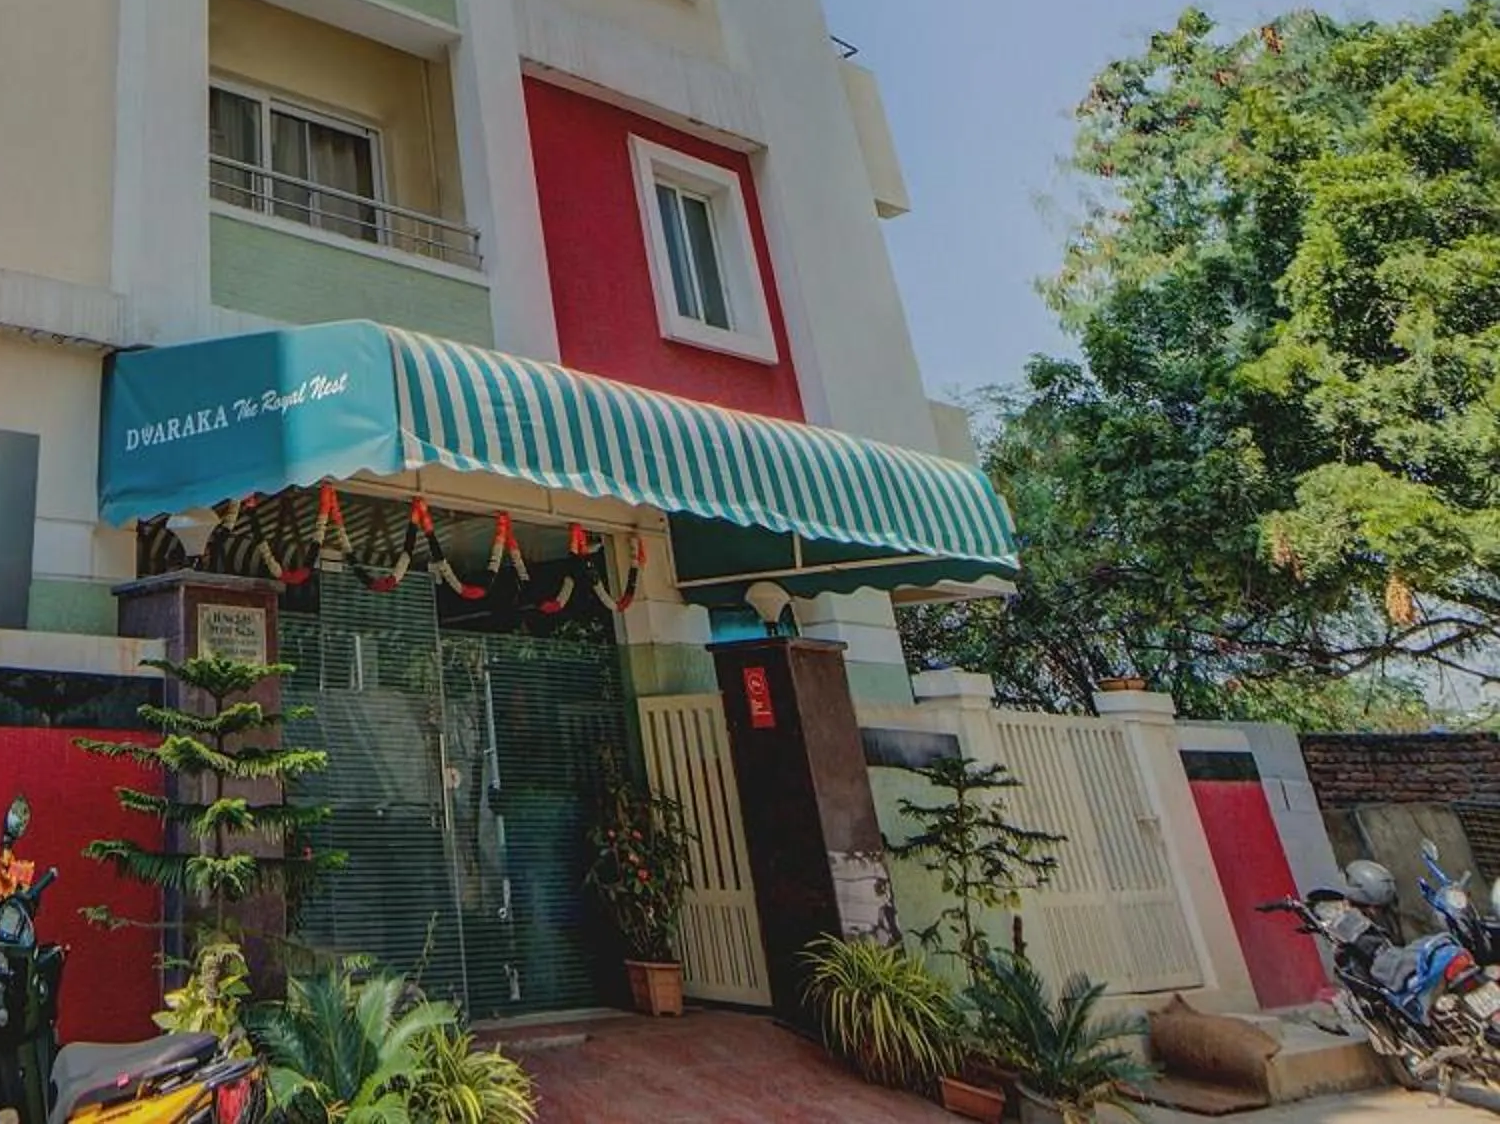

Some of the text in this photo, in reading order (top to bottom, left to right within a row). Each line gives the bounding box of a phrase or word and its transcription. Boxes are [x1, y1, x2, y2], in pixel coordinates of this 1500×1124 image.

[126, 373, 348, 452] DWARAKA The Royal Nest
